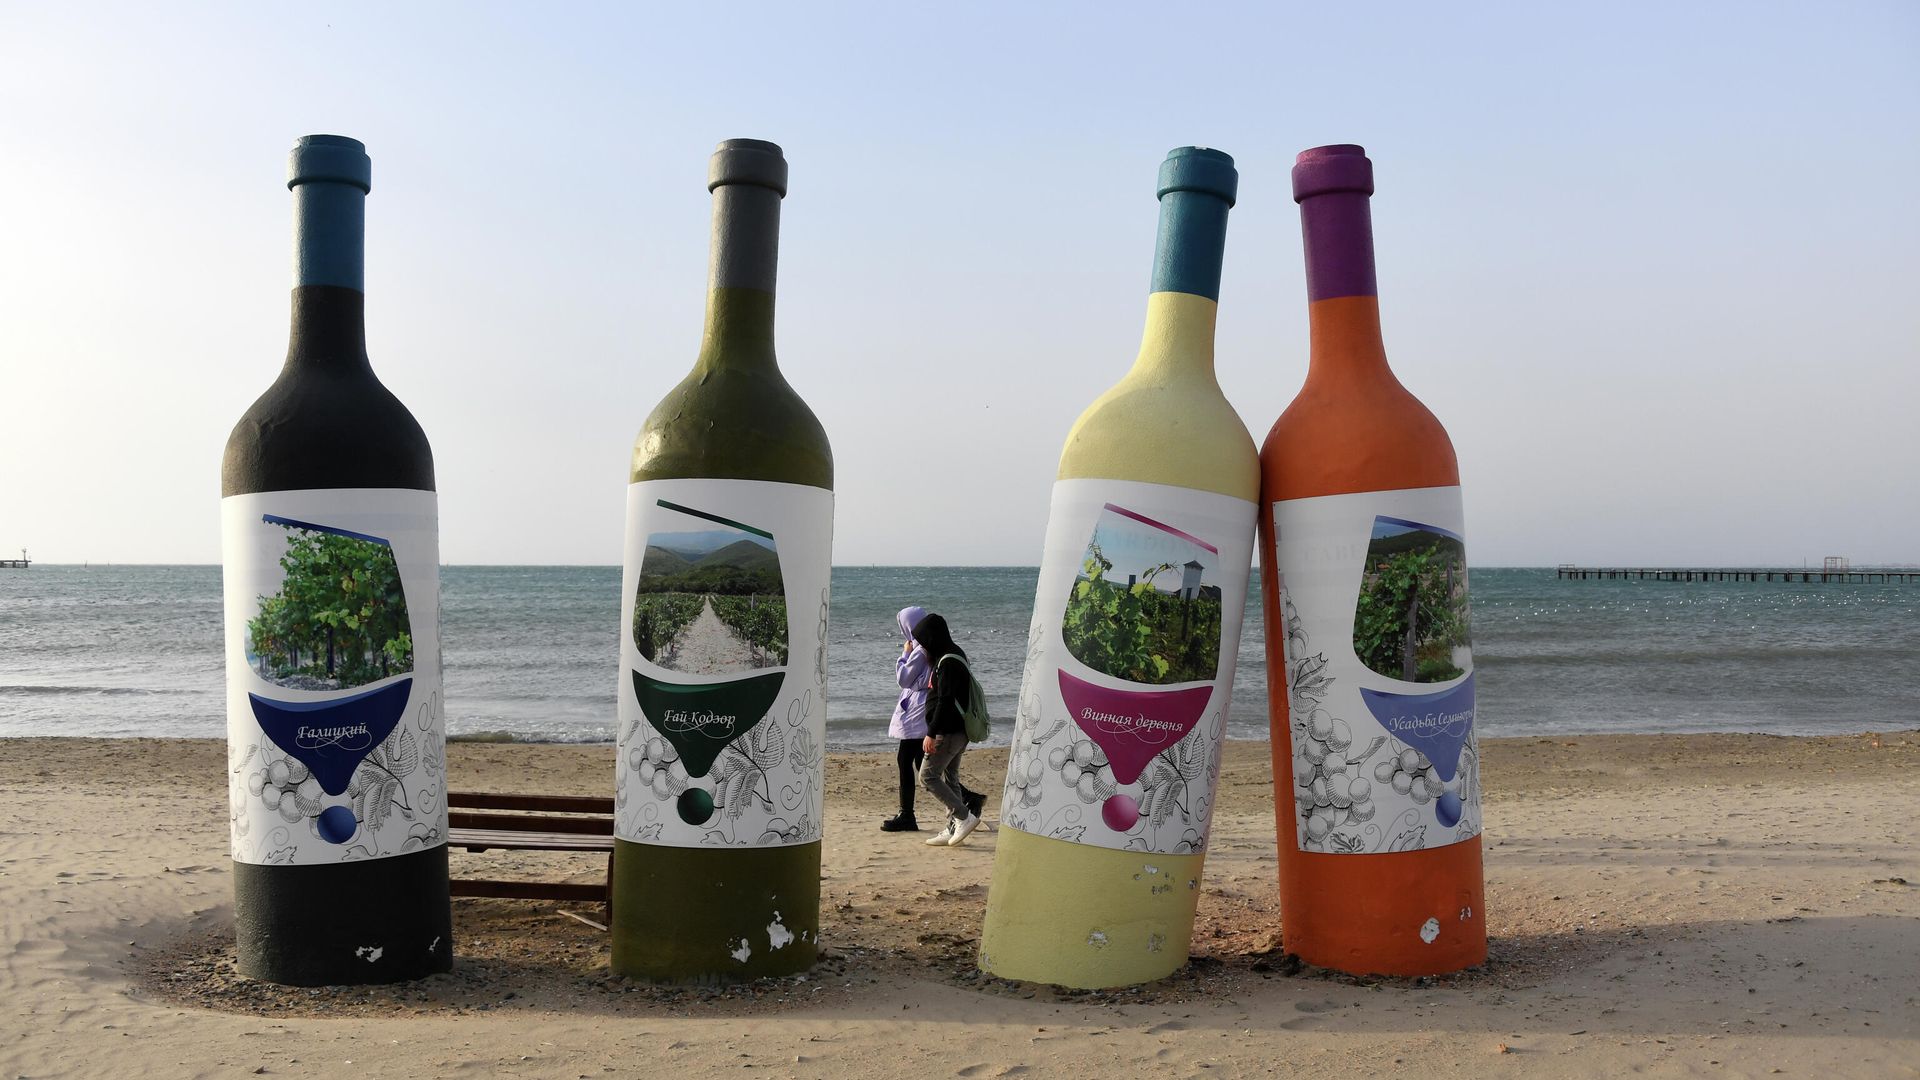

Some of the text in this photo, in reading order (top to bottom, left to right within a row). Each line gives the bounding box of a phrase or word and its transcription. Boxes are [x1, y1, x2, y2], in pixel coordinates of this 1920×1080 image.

[664, 709, 736, 729] Гай-Кодзор
[1080, 706, 1184, 732] Винная деревня
[1389, 713, 1437, 732] Усадьба
[296, 721, 368, 740] Галицкий
